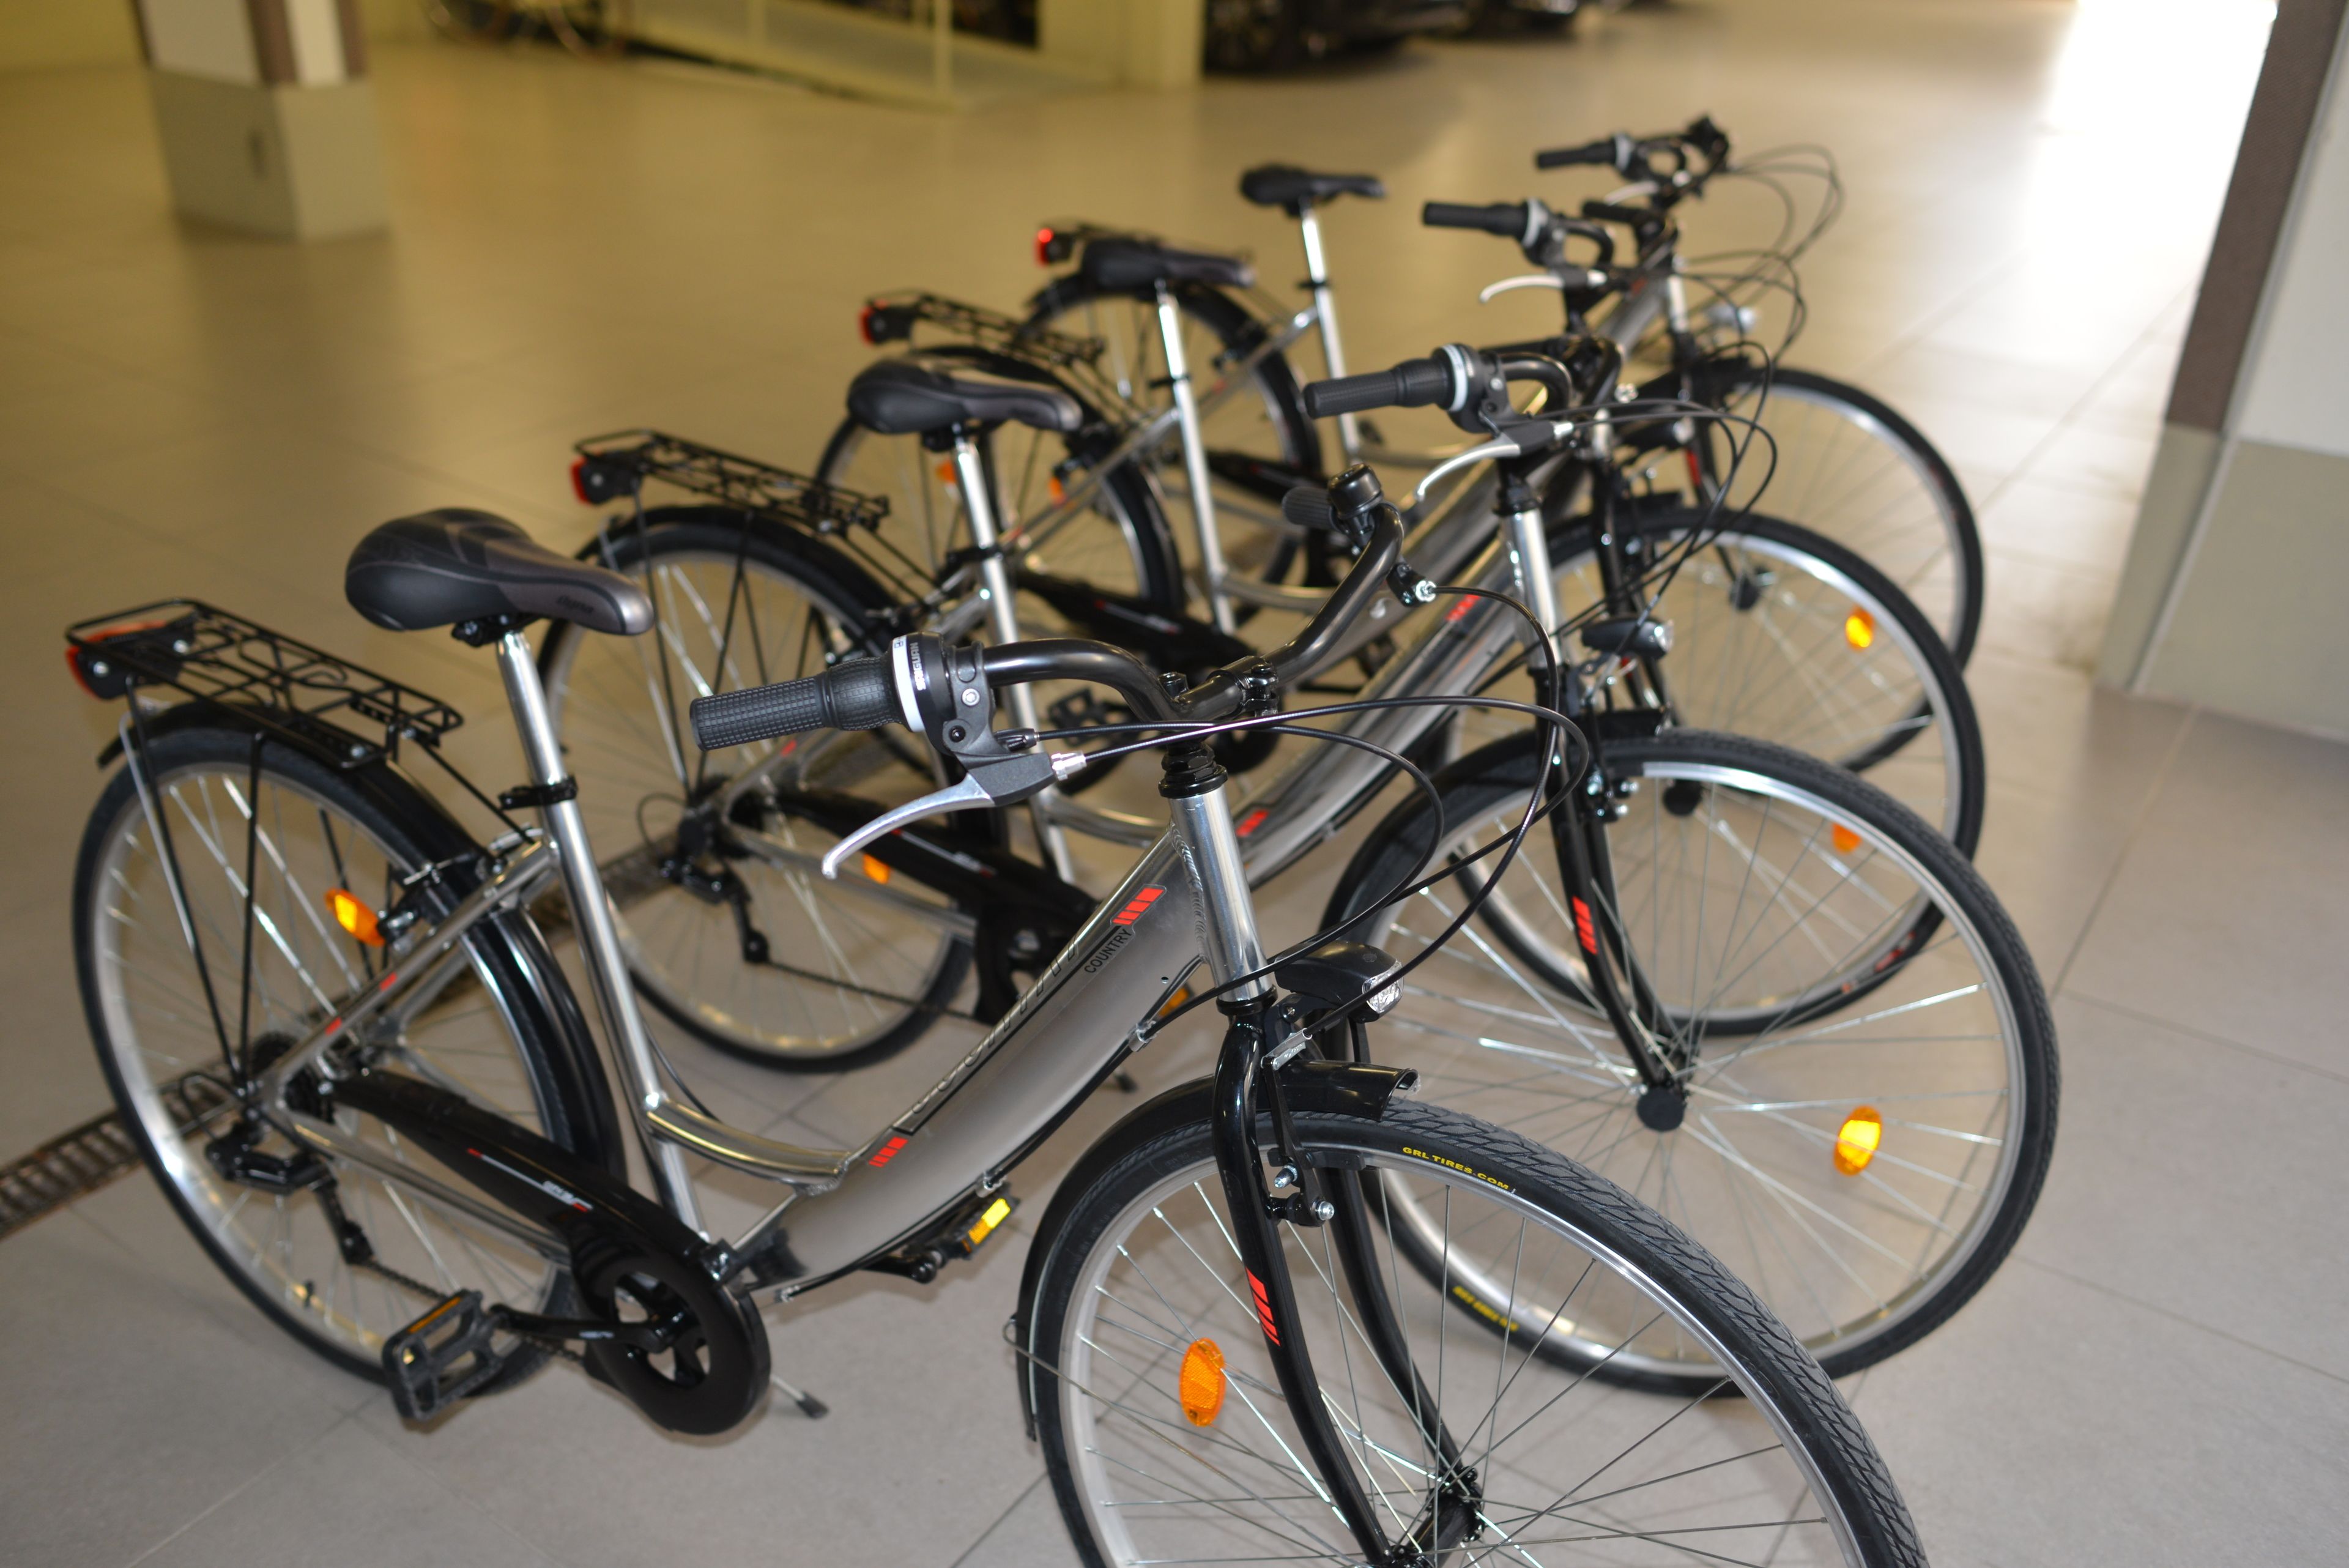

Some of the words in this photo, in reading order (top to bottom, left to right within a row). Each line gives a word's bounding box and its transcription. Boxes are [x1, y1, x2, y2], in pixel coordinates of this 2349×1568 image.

[1084, 929, 1132, 973] COUNTRY
[1402, 1146, 1429, 1159] GRL
[1432, 1154, 1509, 1189] TIRES.COM
